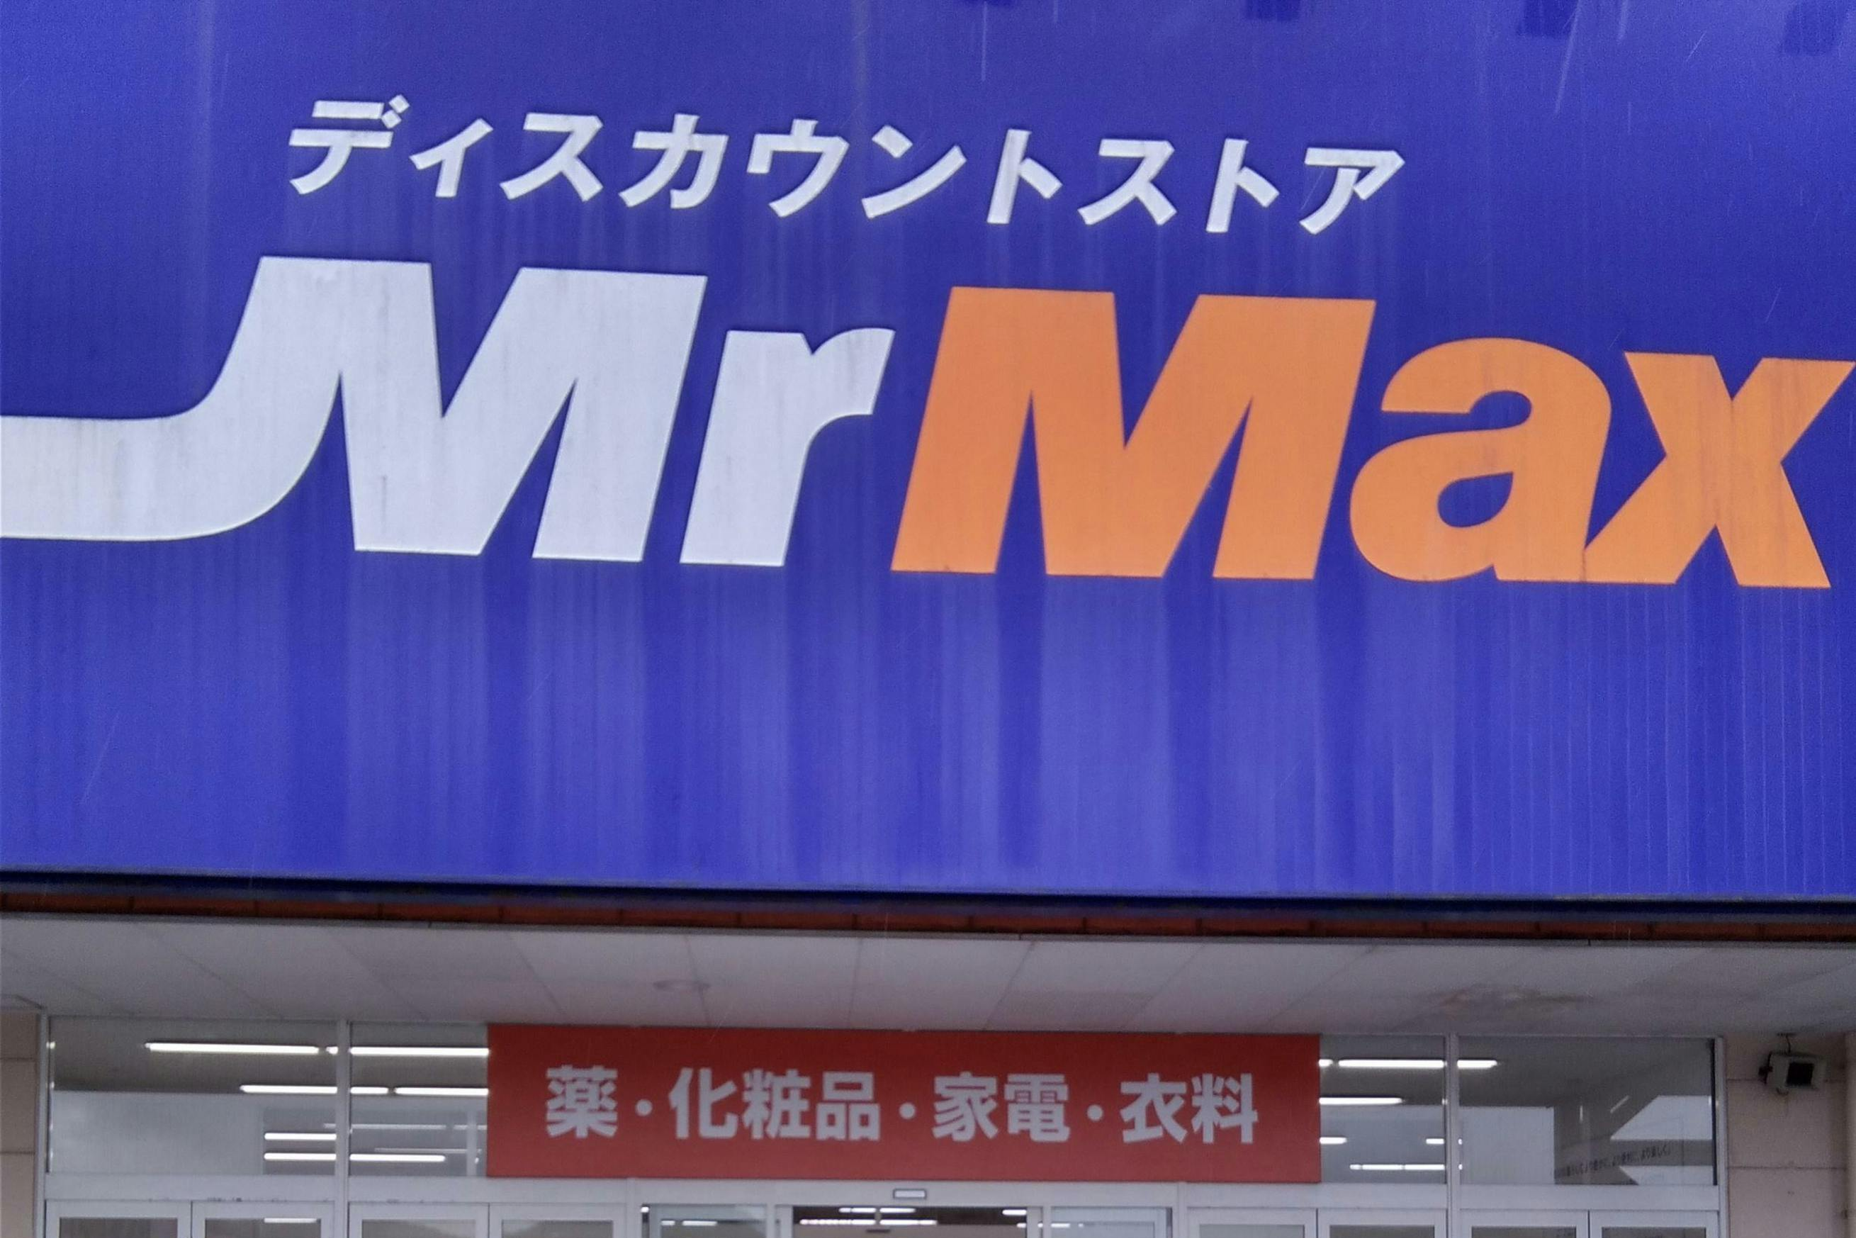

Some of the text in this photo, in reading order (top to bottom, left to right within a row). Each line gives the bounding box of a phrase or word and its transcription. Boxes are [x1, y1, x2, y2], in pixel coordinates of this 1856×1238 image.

[289, 95, 1405, 235] ディスカウントストア
[0, 255, 1856, 590] MrMax
[546, 1064, 1258, 1144] 薬・化粧品・家電・衣料
